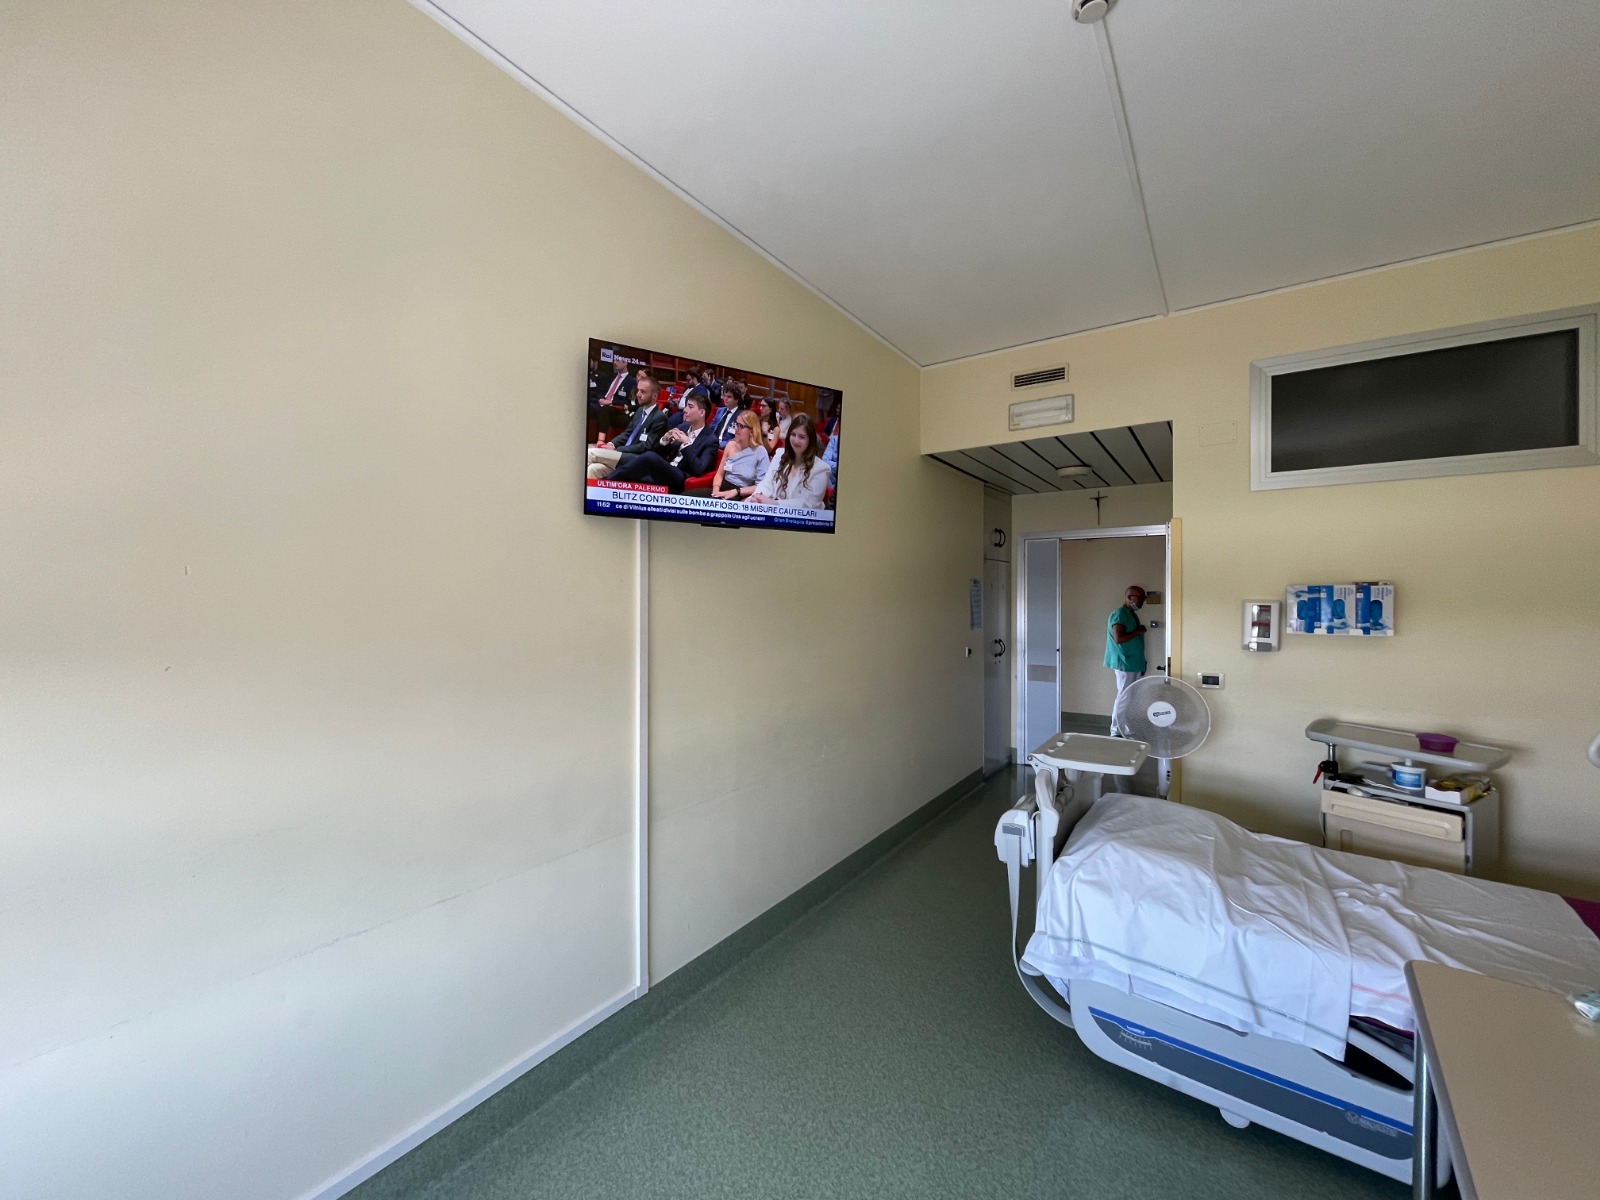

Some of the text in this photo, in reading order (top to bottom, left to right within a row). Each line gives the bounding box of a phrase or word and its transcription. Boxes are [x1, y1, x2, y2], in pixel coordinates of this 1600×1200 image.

[602, 351, 612, 359] Rai
[614, 354, 631, 363] News
[597, 480, 666, 493] ULTIM'ORA PALERMO
[612, 491, 817, 518] BLITZ CONTRO CLAN MAFIOSO: 18 MISURE CAUTELARI
